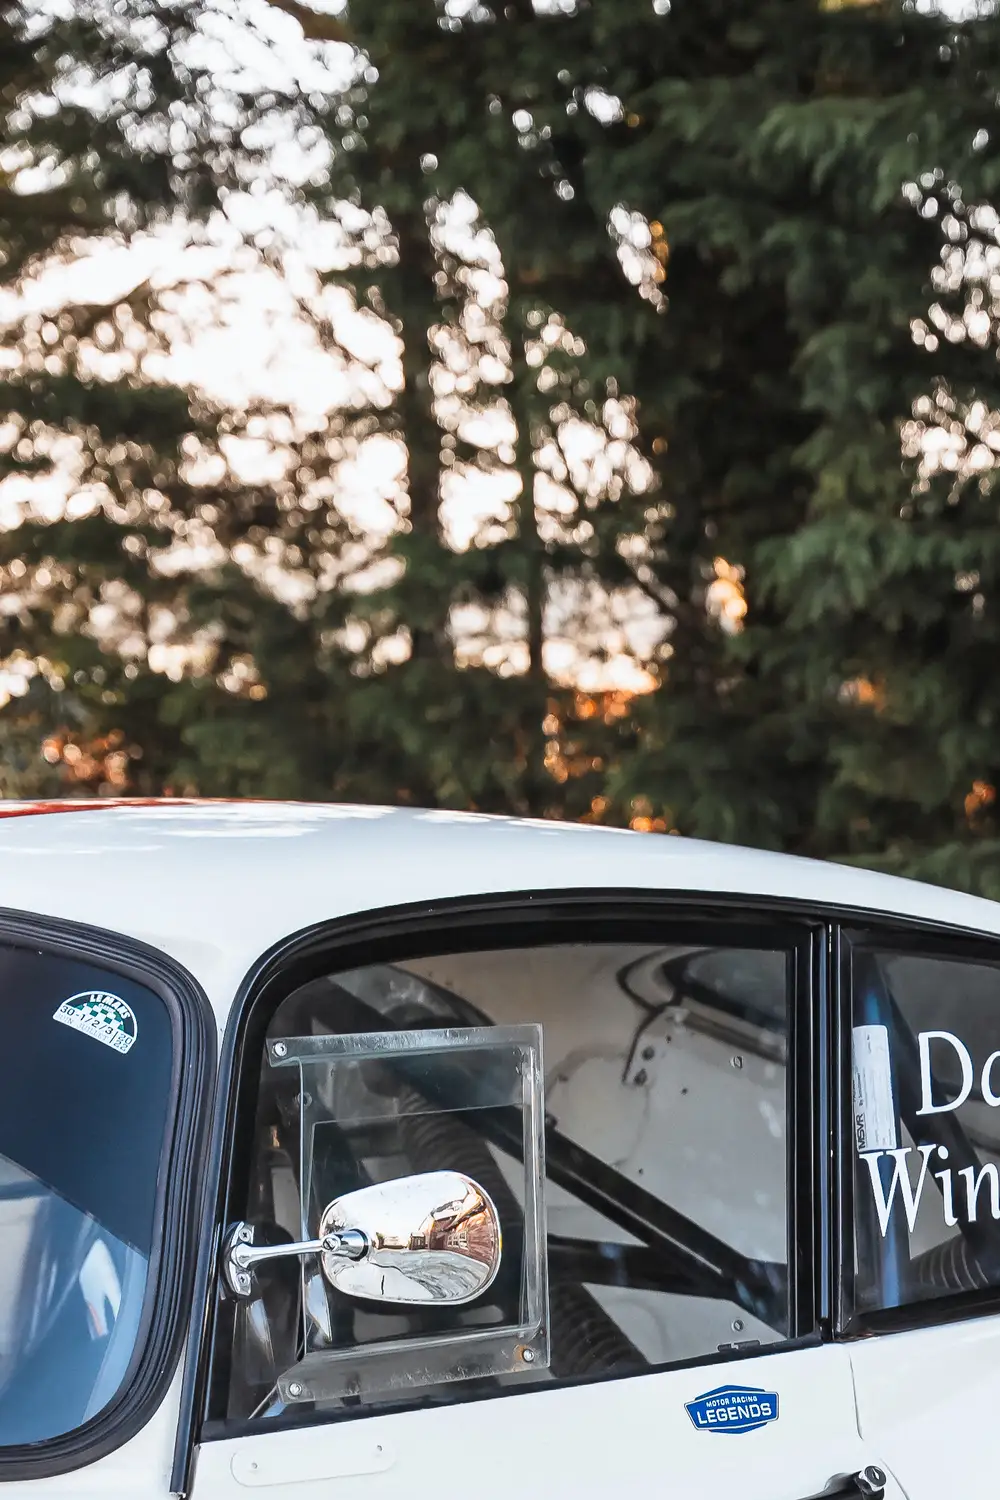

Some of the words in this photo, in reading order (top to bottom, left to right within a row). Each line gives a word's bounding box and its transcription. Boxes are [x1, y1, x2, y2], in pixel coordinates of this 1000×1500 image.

[855, 1113, 866, 1150] MSVR
[706, 1397, 730, 1407] MOTOR
[731, 1395, 758, 1404] RACING
[697, 1402, 772, 1425] LEGENDS
